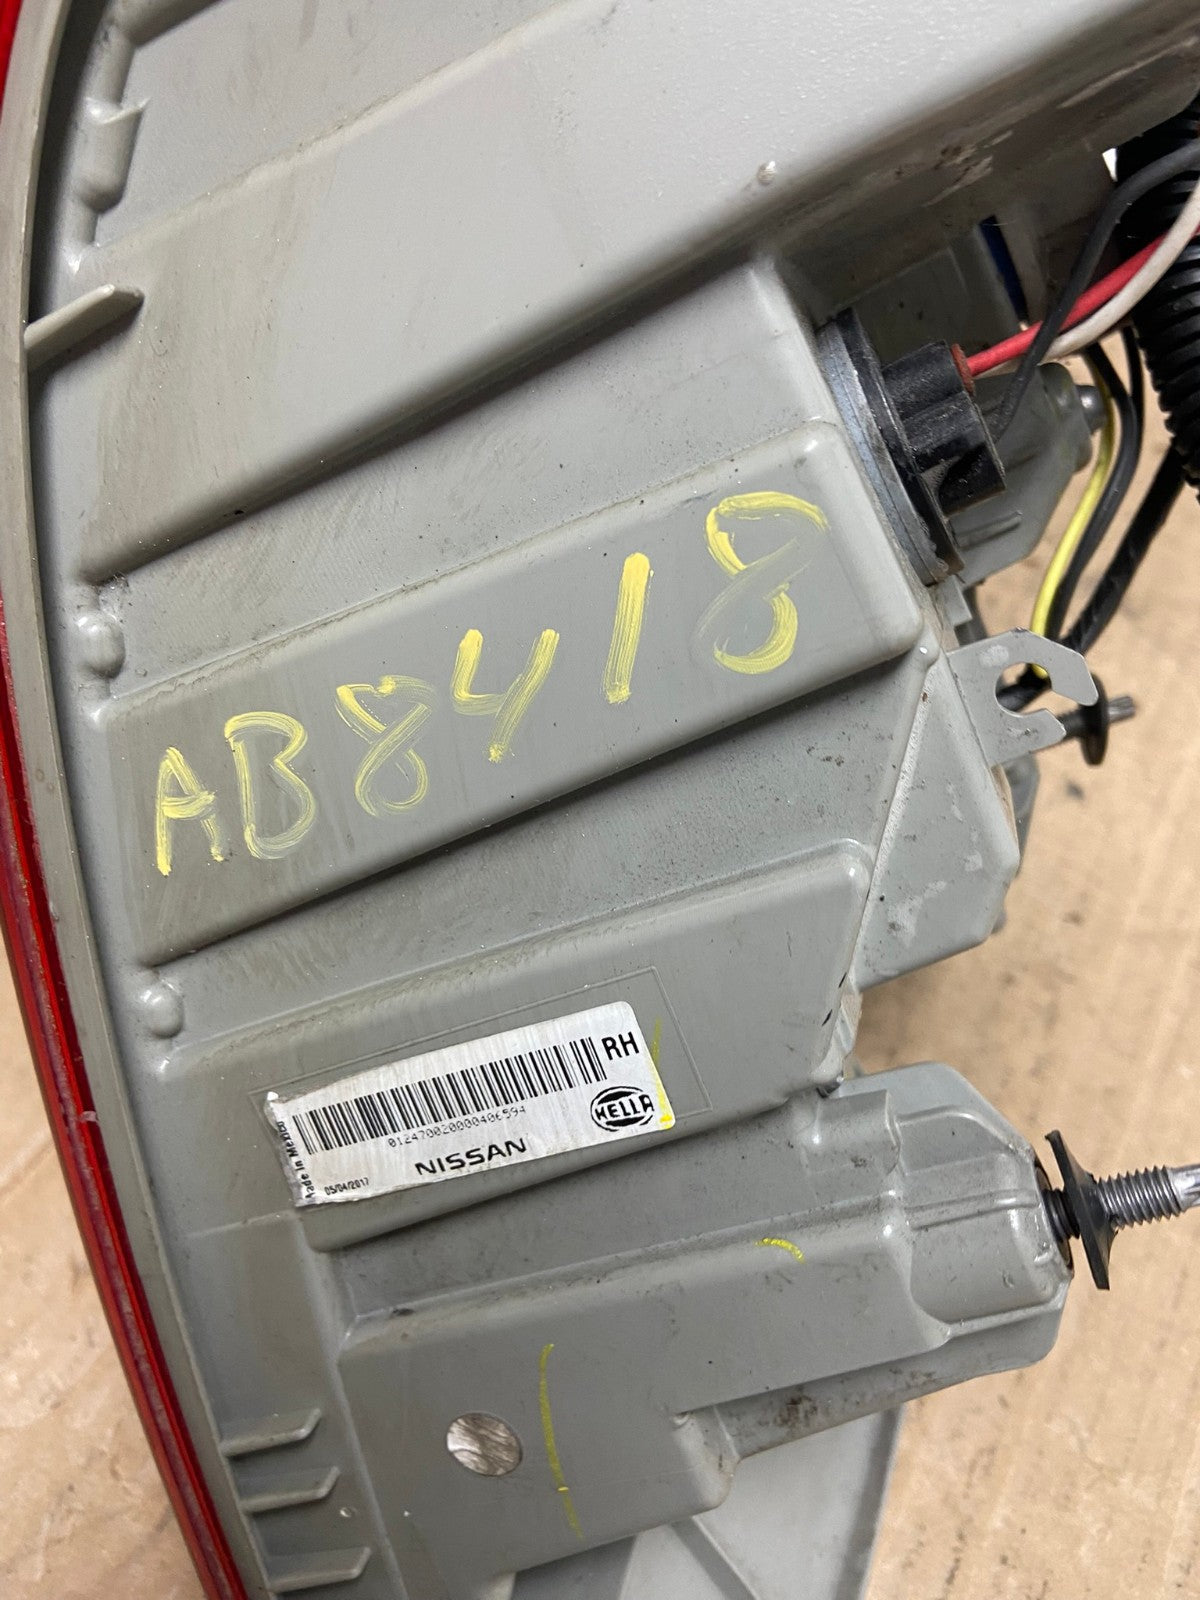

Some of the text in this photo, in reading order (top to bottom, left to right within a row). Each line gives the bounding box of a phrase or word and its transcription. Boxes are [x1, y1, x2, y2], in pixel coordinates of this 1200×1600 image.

[602, 1031, 640, 1060] RH
[594, 1094, 655, 1121] HELLA
[276, 1120, 300, 1157] Mexico
[414, 1138, 528, 1176] NISSAN
[324, 1177, 370, 1196] 05/04/2017
